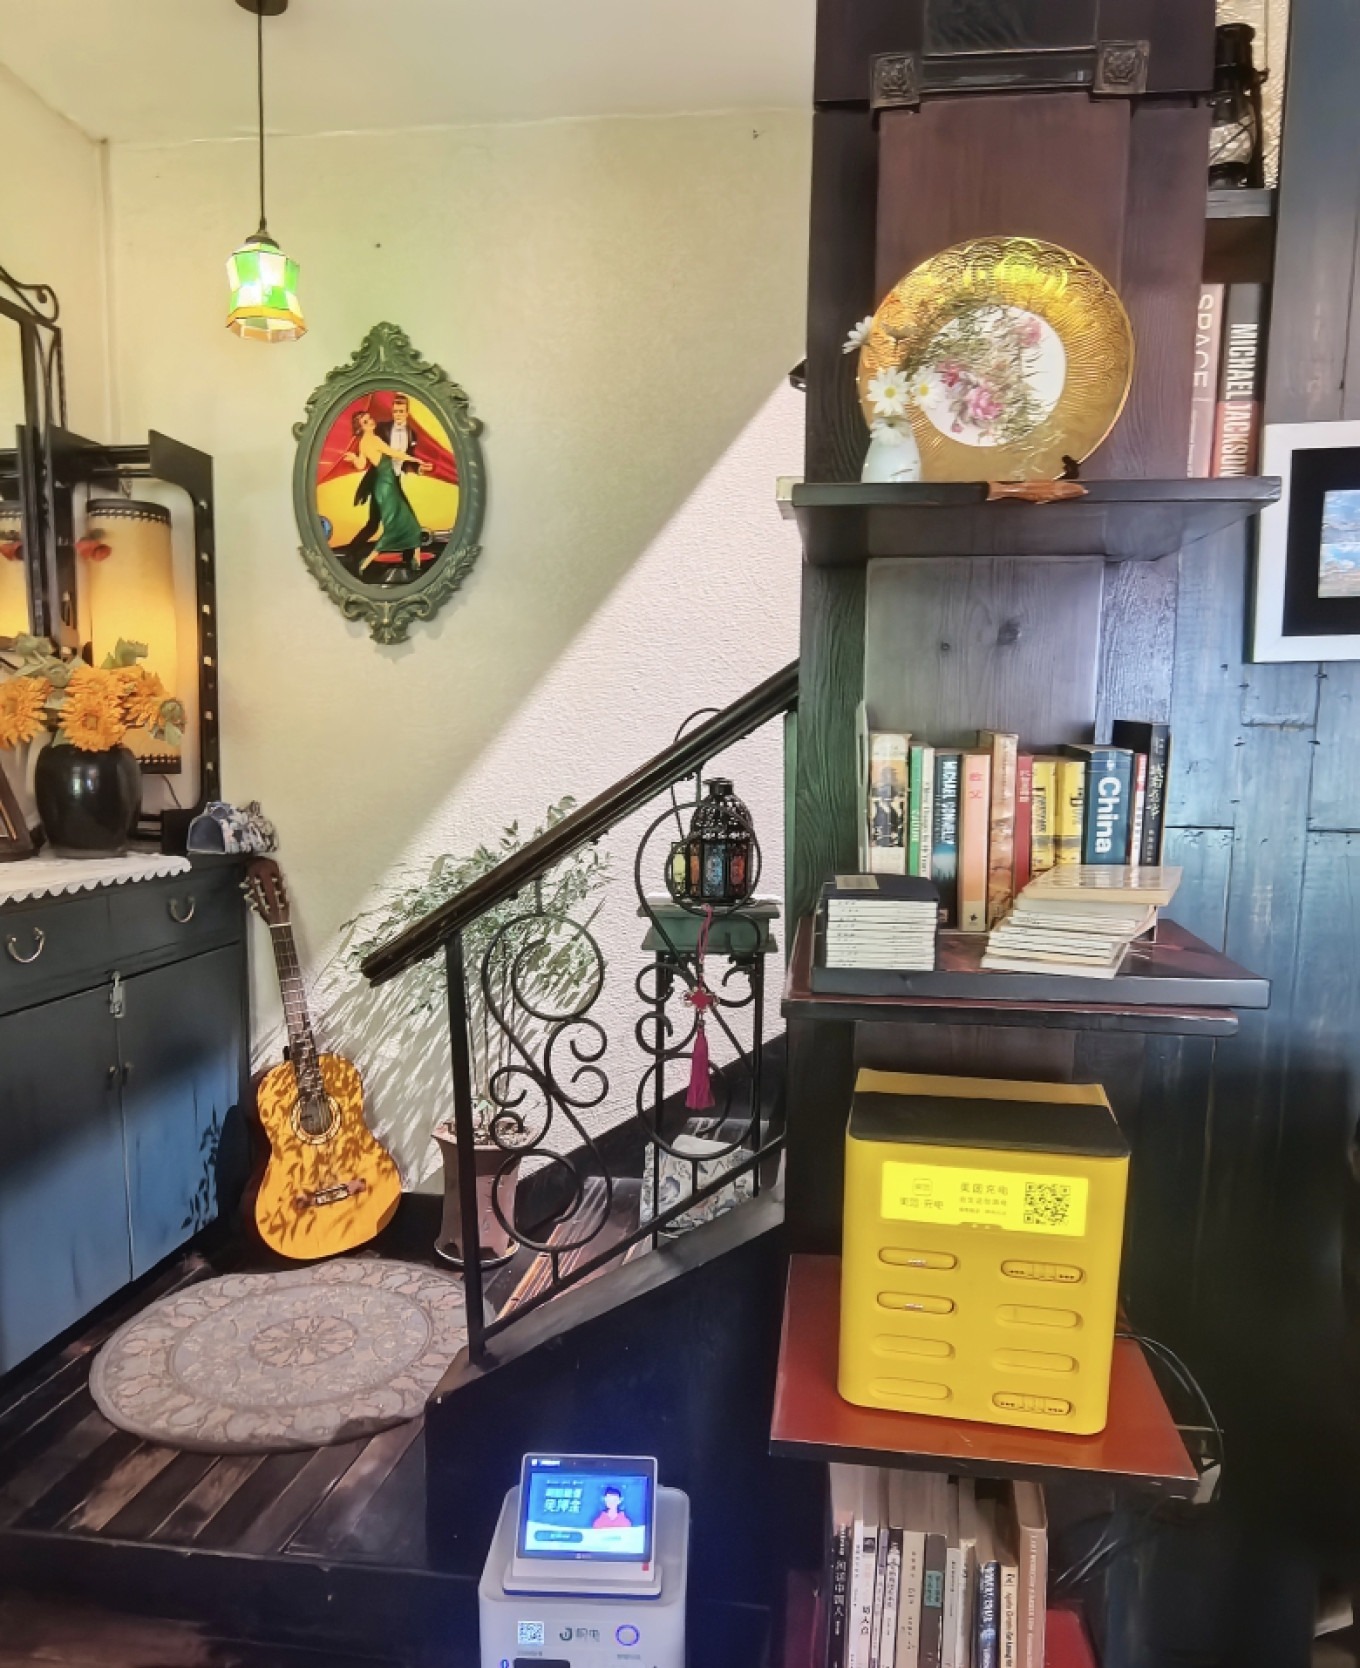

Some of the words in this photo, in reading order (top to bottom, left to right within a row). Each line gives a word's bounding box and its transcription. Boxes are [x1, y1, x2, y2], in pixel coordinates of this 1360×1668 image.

[1192, 294, 1215, 388] SPACE
[1226, 323, 1258, 400] MICHAEL
[1220, 402, 1253, 477] JACKSON
[942, 761, 958, 798] MICHAEL
[1095, 777, 1122, 854] China
